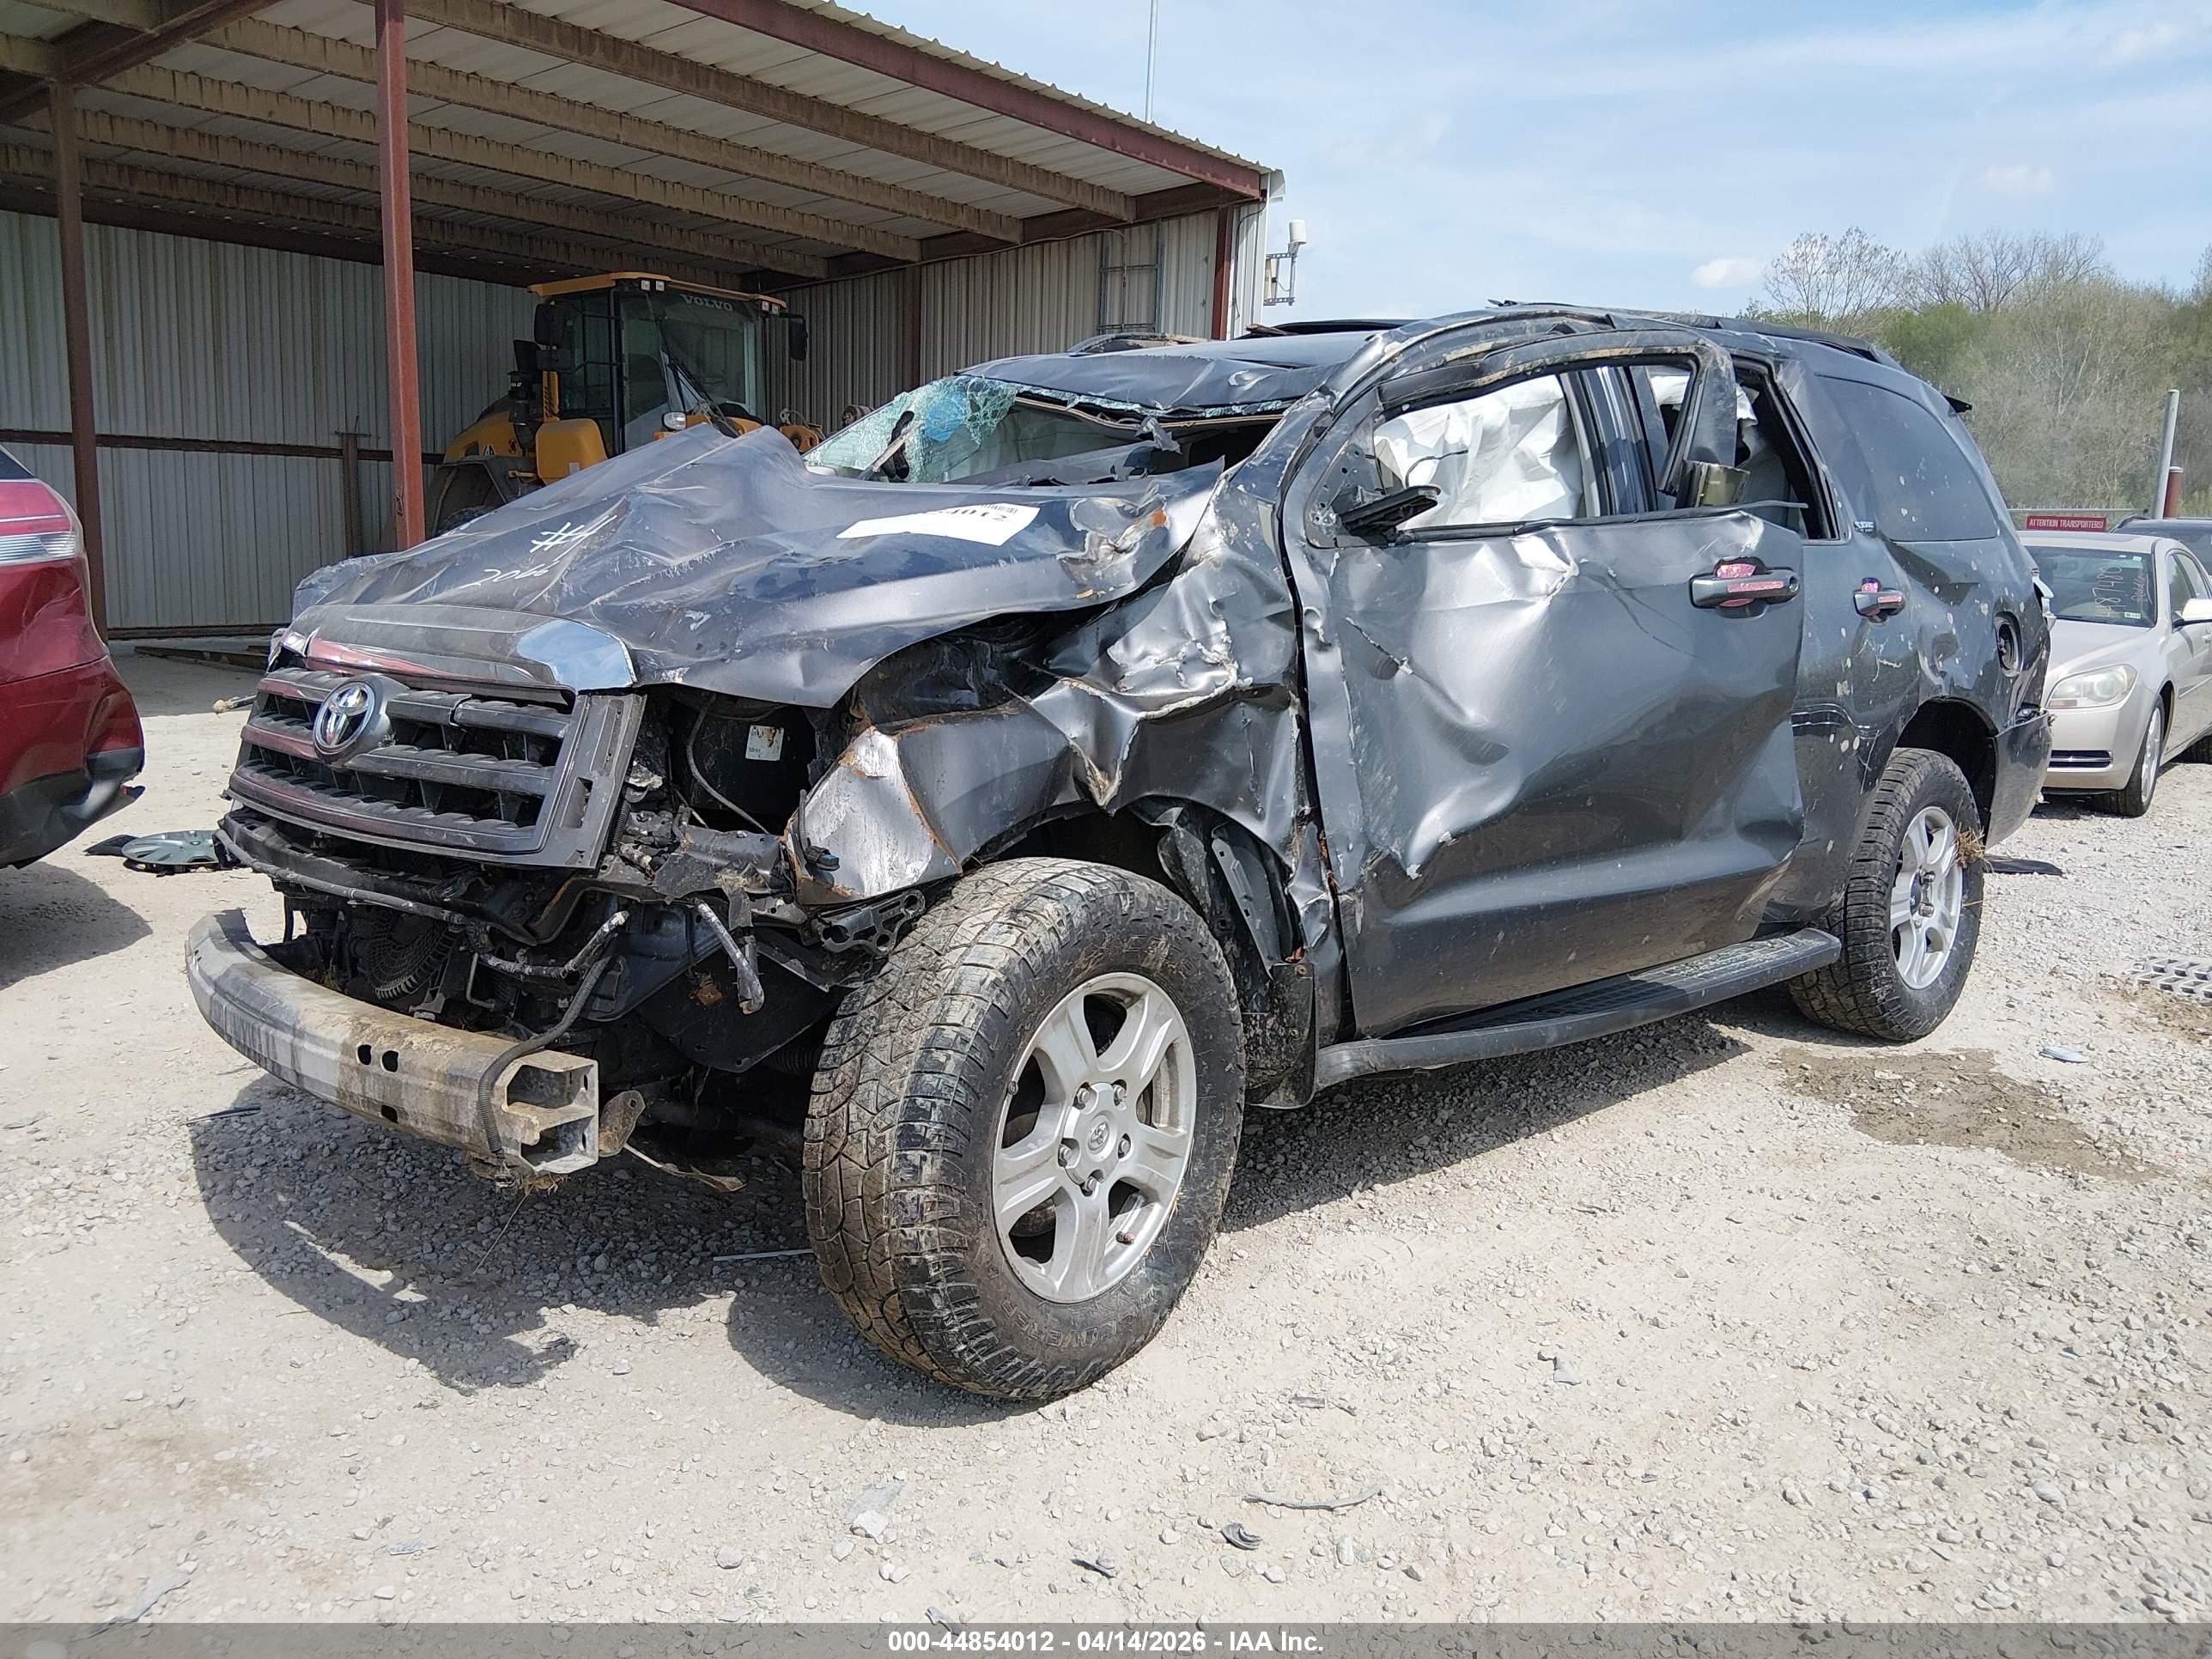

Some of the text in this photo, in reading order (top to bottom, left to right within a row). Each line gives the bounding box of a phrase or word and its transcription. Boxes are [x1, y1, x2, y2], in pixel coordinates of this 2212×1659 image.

[680, 294, 733, 312] VOLVO
[2029, 519, 2104, 529] ATTENTION TRANSPORTERS!
